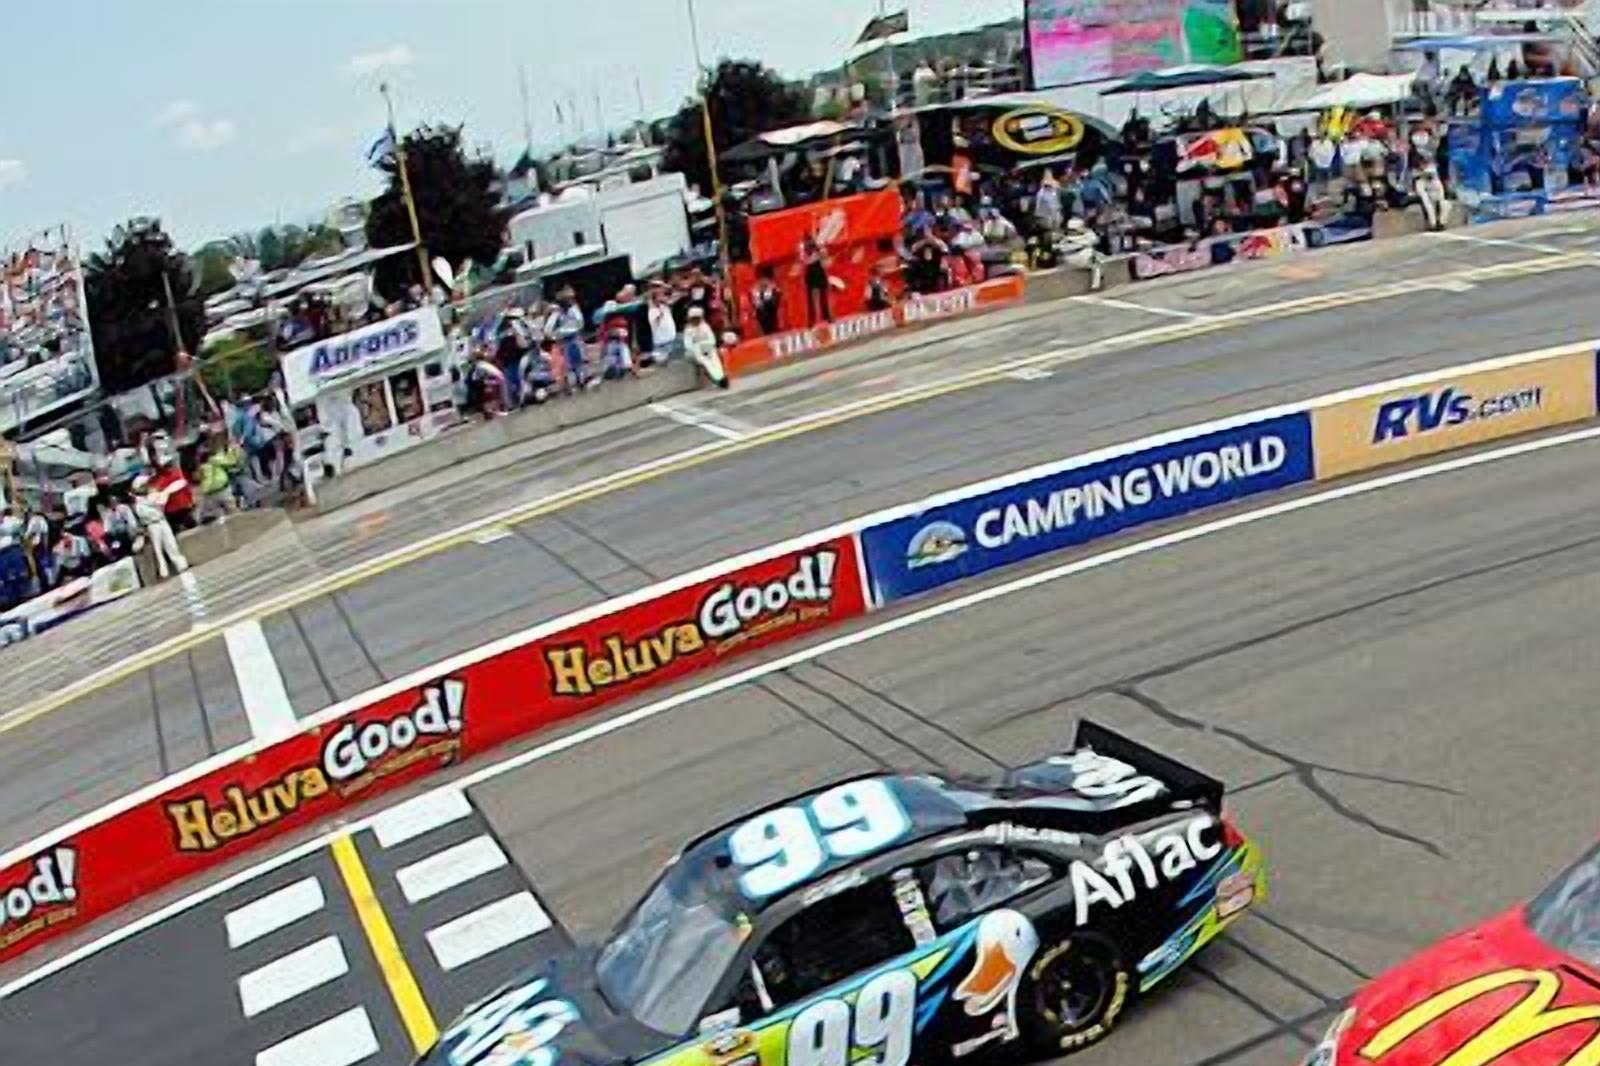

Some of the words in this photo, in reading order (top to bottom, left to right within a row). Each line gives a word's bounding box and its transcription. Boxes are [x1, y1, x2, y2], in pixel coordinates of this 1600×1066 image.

[974, 466, 1154, 549] CAMPING
[1154, 434, 1287, 498] WORLD
[547, 620, 705, 694] Heluva
[700, 550, 837, 638] Good!
[168, 766, 329, 851] Heluva
[323, 679, 467, 780] Good!
[728, 777, 912, 900] 99
[1069, 814, 1223, 925] Aflac
